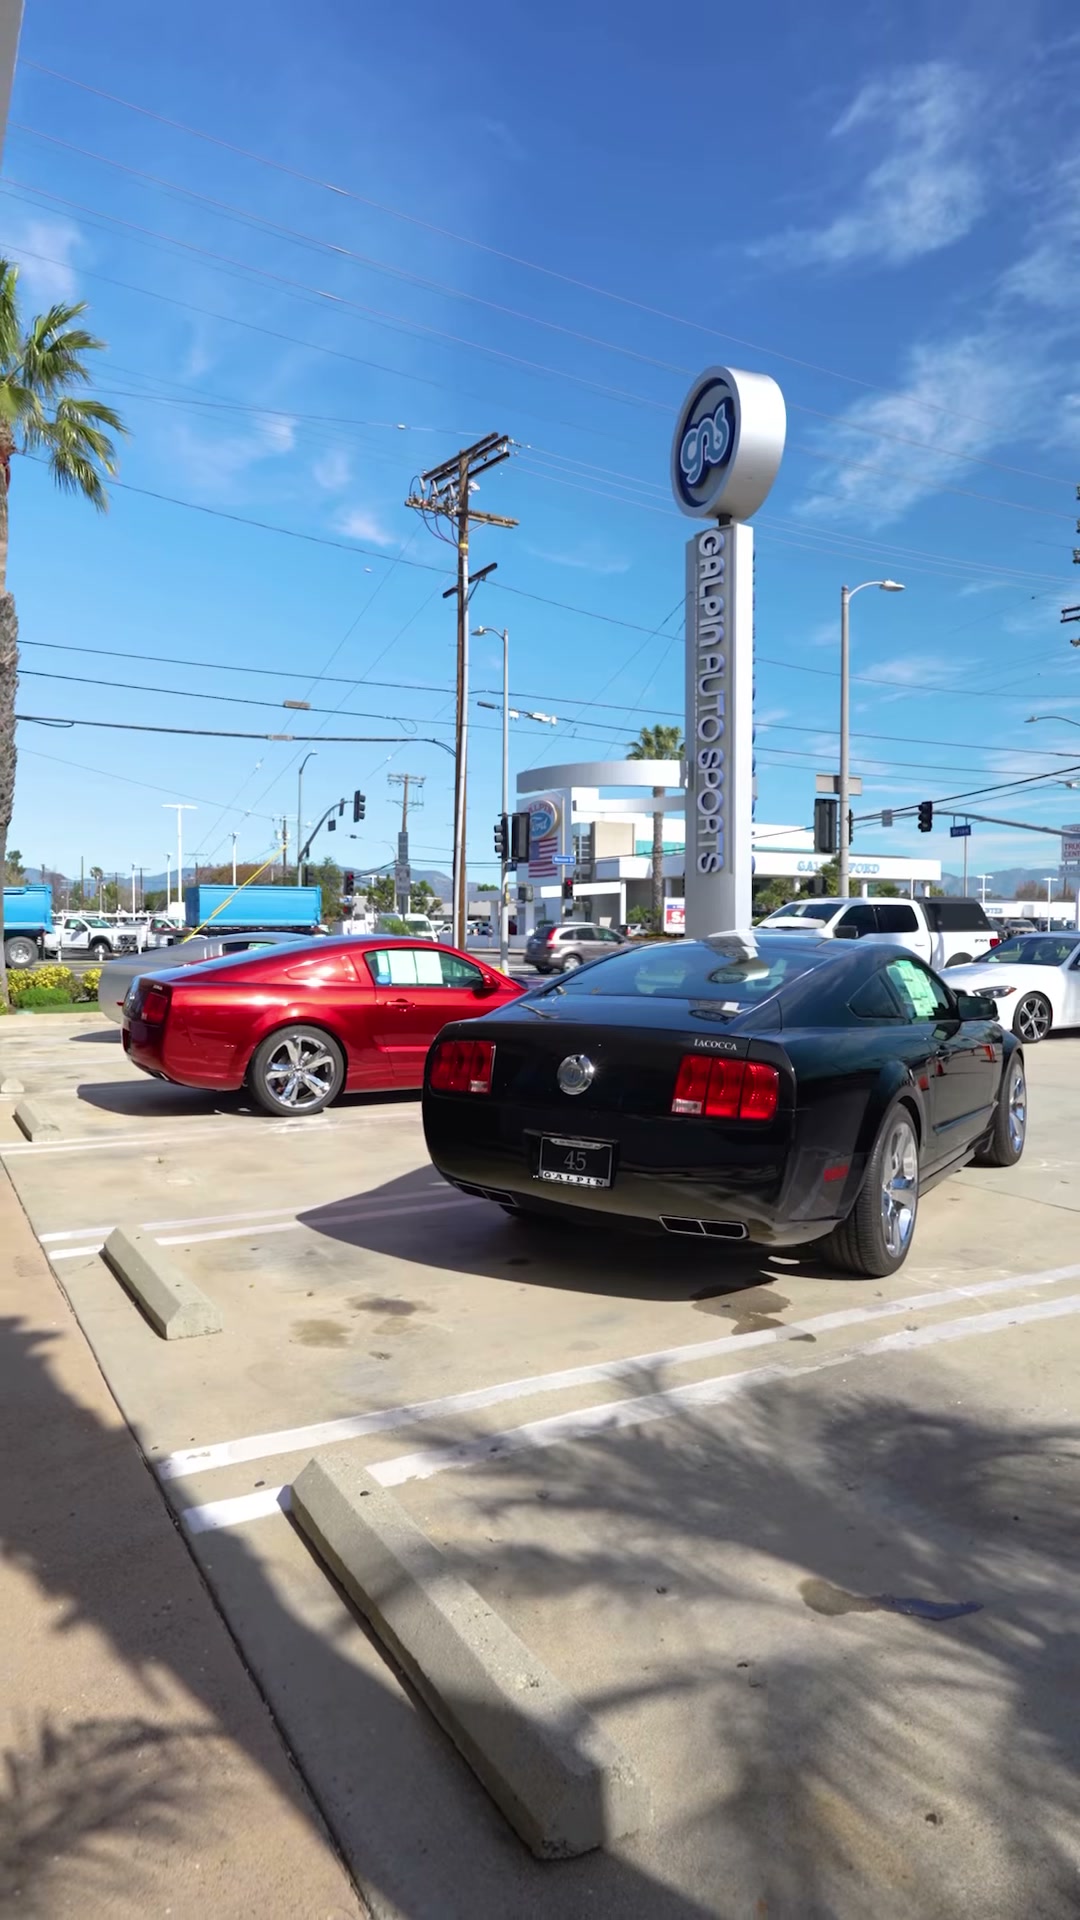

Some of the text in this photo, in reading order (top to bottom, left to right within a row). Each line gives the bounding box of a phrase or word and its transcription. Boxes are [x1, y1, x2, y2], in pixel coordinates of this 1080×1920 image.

[697, 529, 725, 873] GALPIN AUTO SPORTS
[694, 1038, 737, 1050] IACOCCA
[563, 1150, 587, 1171] 45
[544, 1171, 604, 1186] GALPIN
